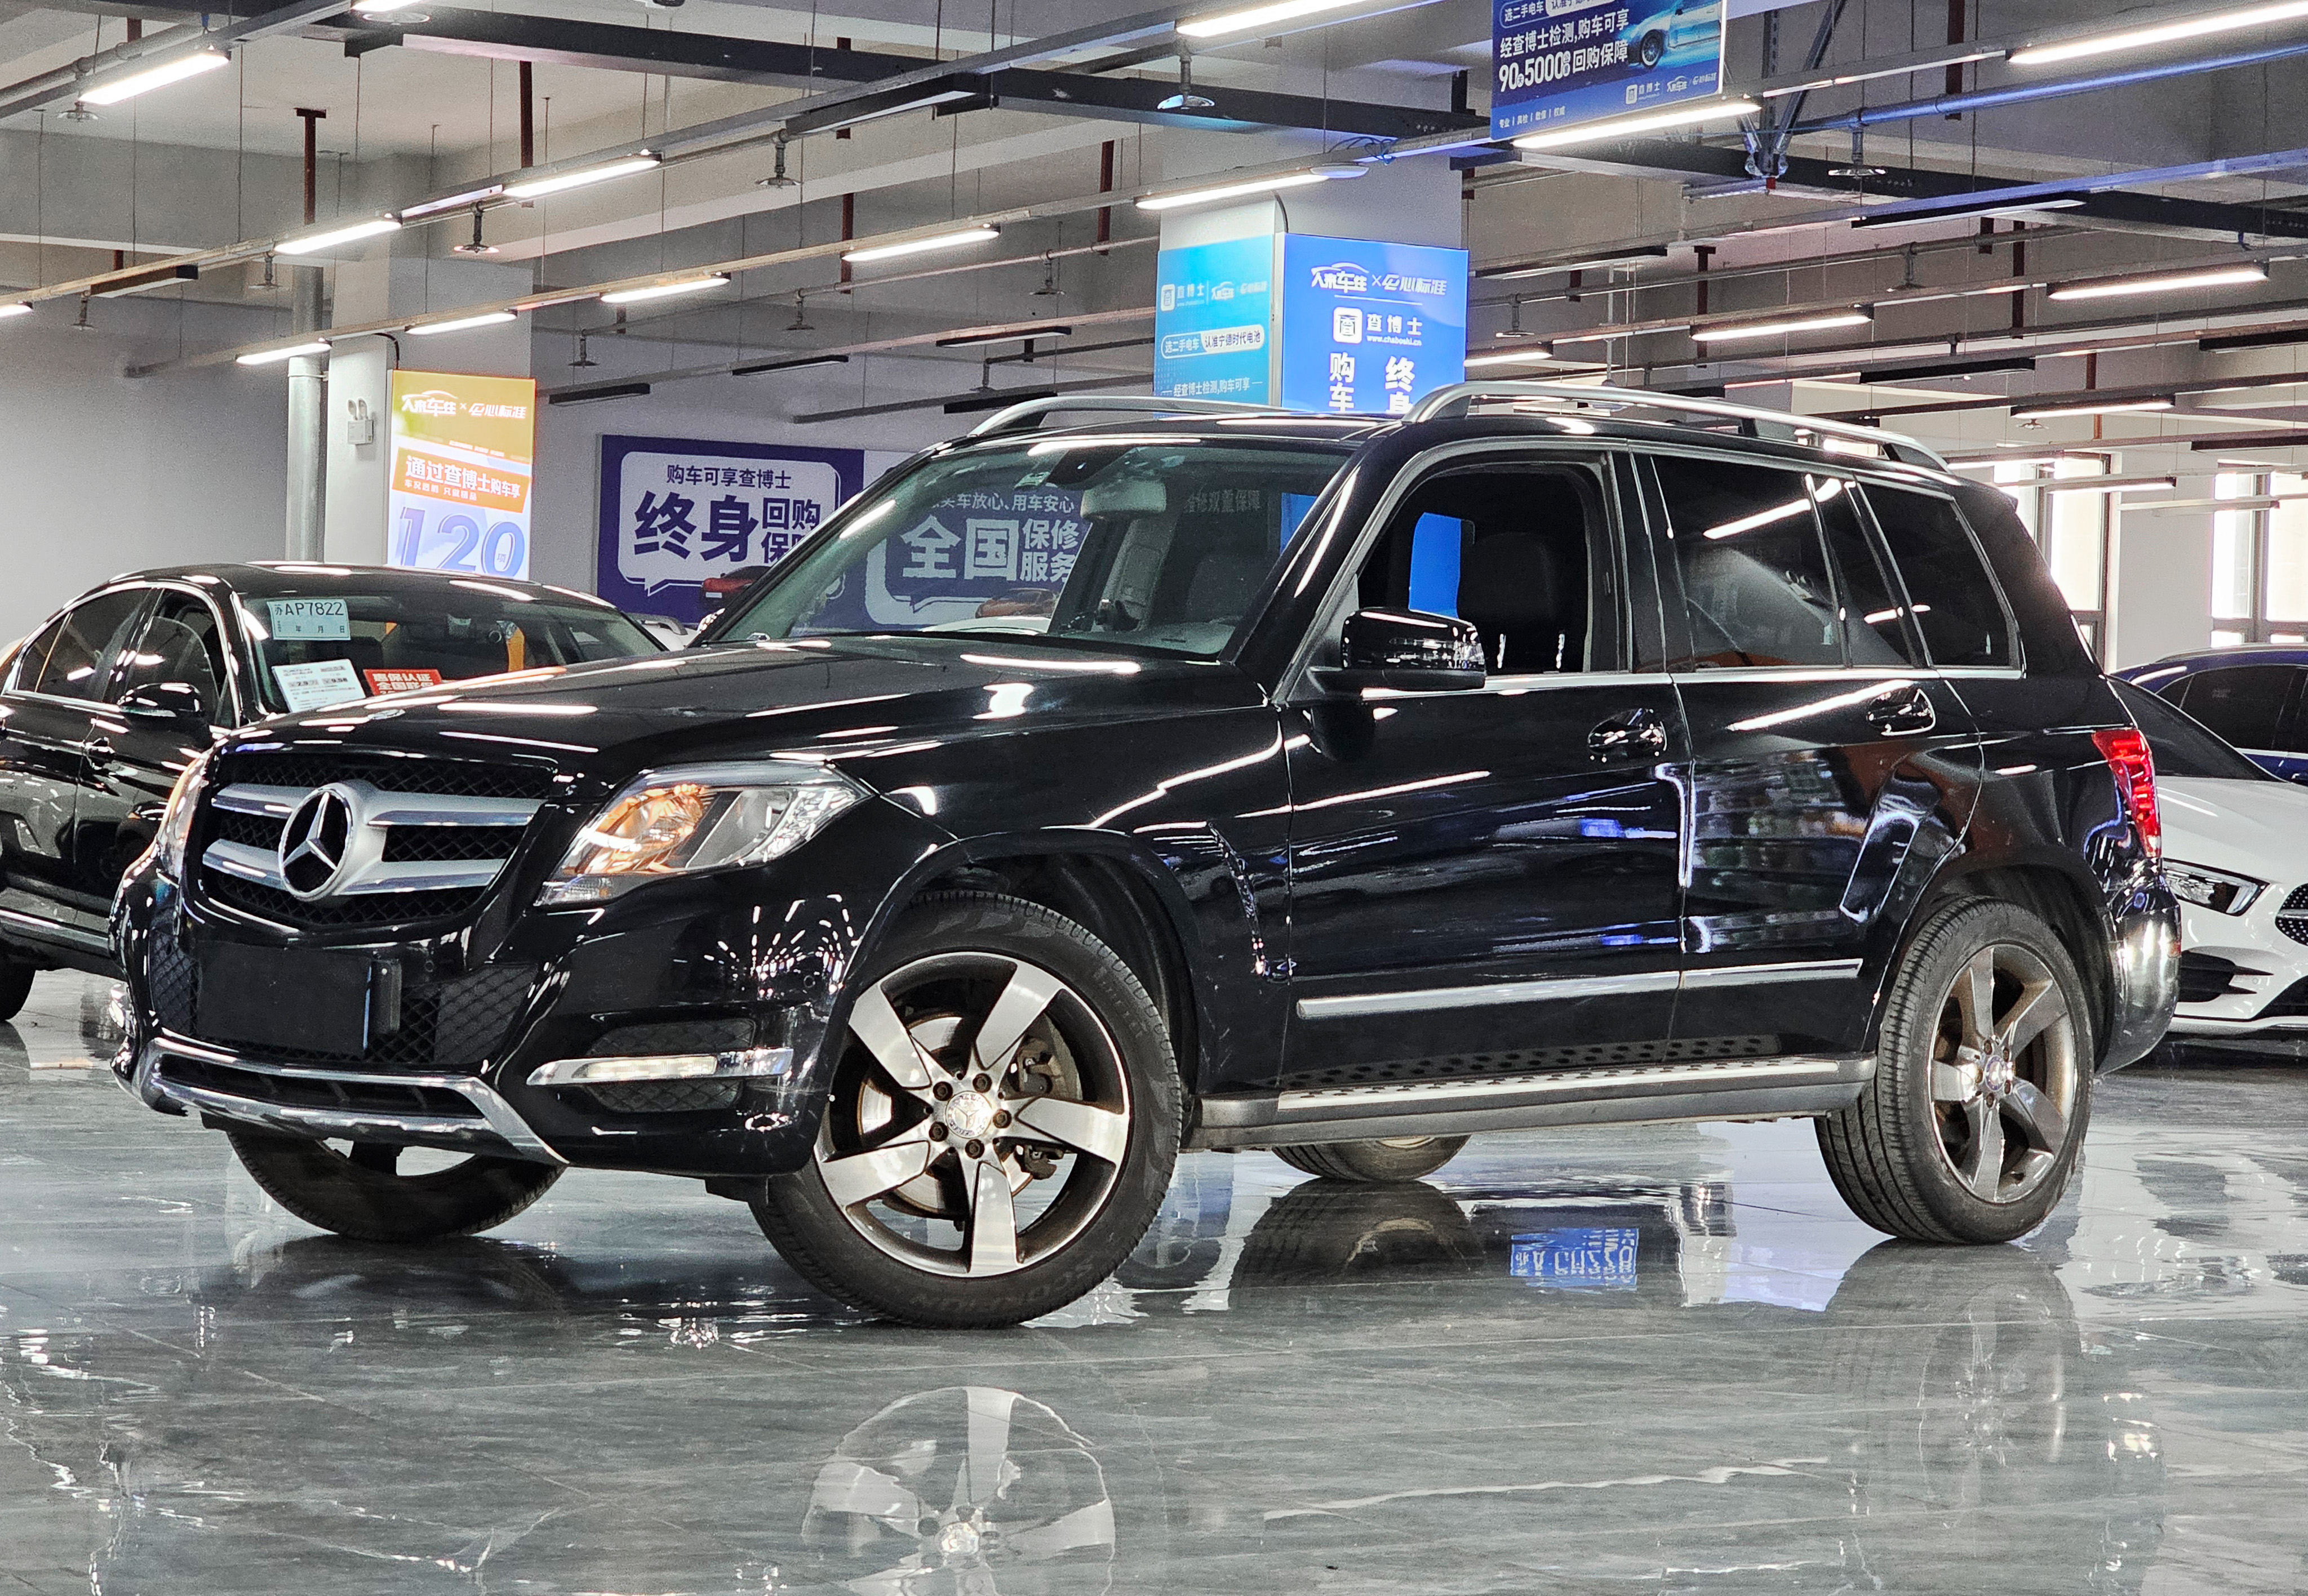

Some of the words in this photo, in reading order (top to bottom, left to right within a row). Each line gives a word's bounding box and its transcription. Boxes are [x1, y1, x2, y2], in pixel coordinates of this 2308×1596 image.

[1504, 2, 1544, 22] 选二手电车
[1366, 313, 1423, 336] 查博士
[1165, 337, 1200, 353] 选二手电车
[1205, 330, 1261, 348] 认准宁德时代电池
[405, 455, 521, 499] 通过查博士购车享
[667, 464, 792, 489] 购车可享查博士
[633, 490, 759, 562] 终身
[762, 497, 821, 530] 回购
[400, 506, 525, 577] 120
[761, 531, 806, 563] 保
[900, 514, 1019, 581] 全国
[1022, 518, 1080, 550] 保修
[496, 553, 506, 563] 项
[1020, 551, 1076, 583] 服务
[274, 602, 344, 616] 苏AP7822
